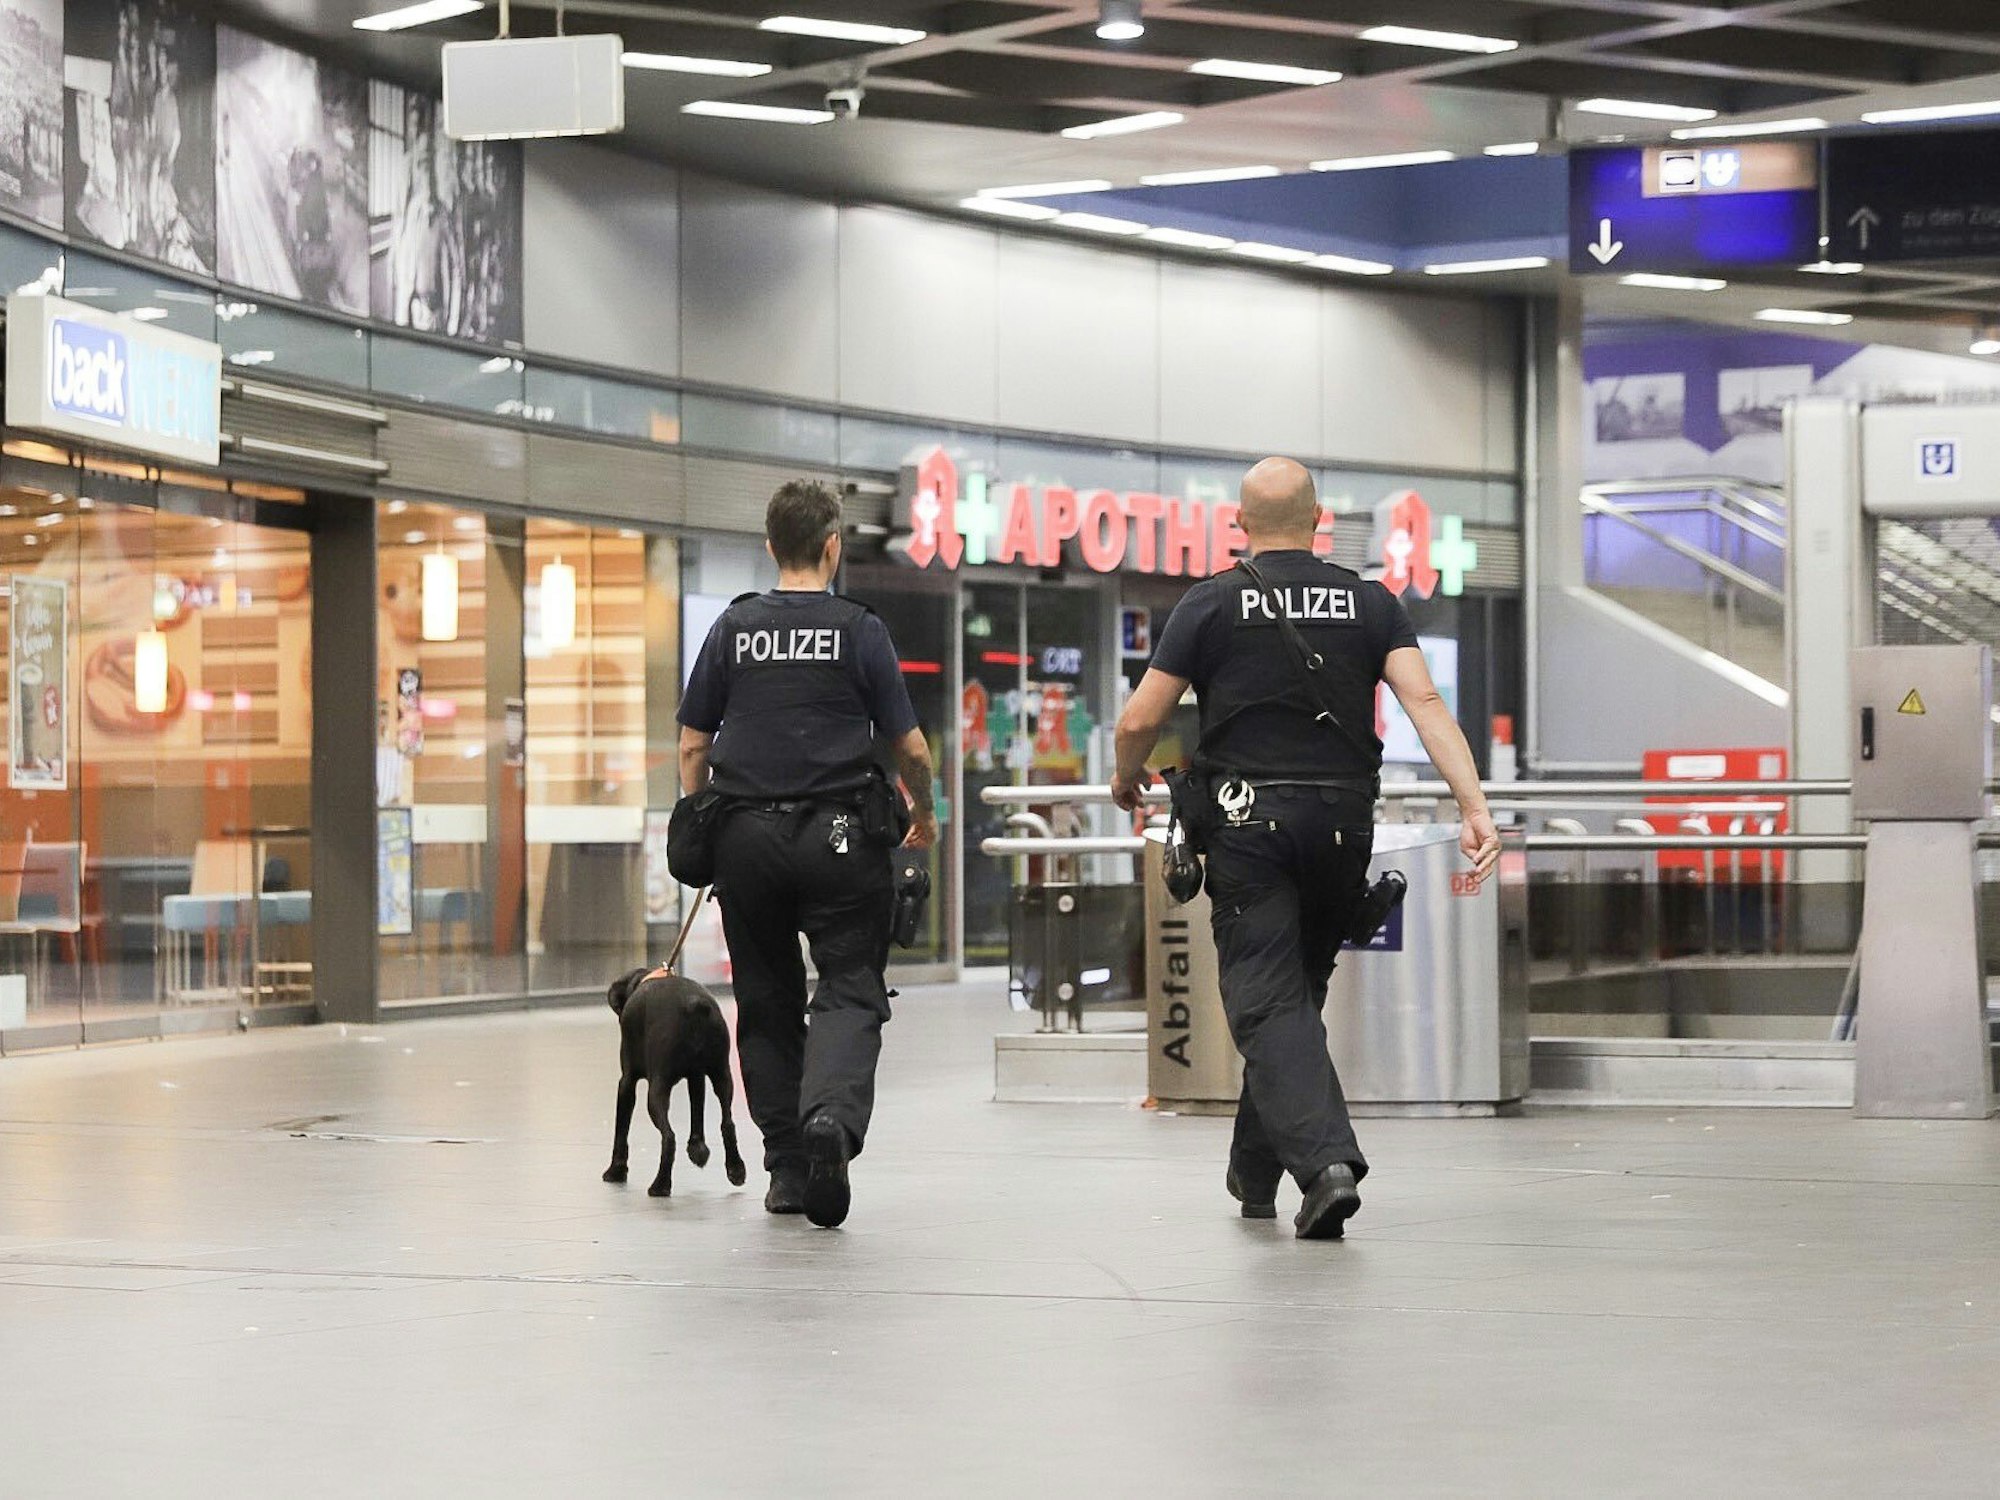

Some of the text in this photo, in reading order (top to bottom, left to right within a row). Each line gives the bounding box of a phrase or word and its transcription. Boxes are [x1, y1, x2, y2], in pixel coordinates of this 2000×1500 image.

[53, 323, 125, 417] back
[998, 482, 1336, 577] APOTHE
[735, 628, 841, 664] POLIZEI
[1240, 586, 1357, 621] POLIZEI
[1160, 920, 1191, 1069] Abfall
